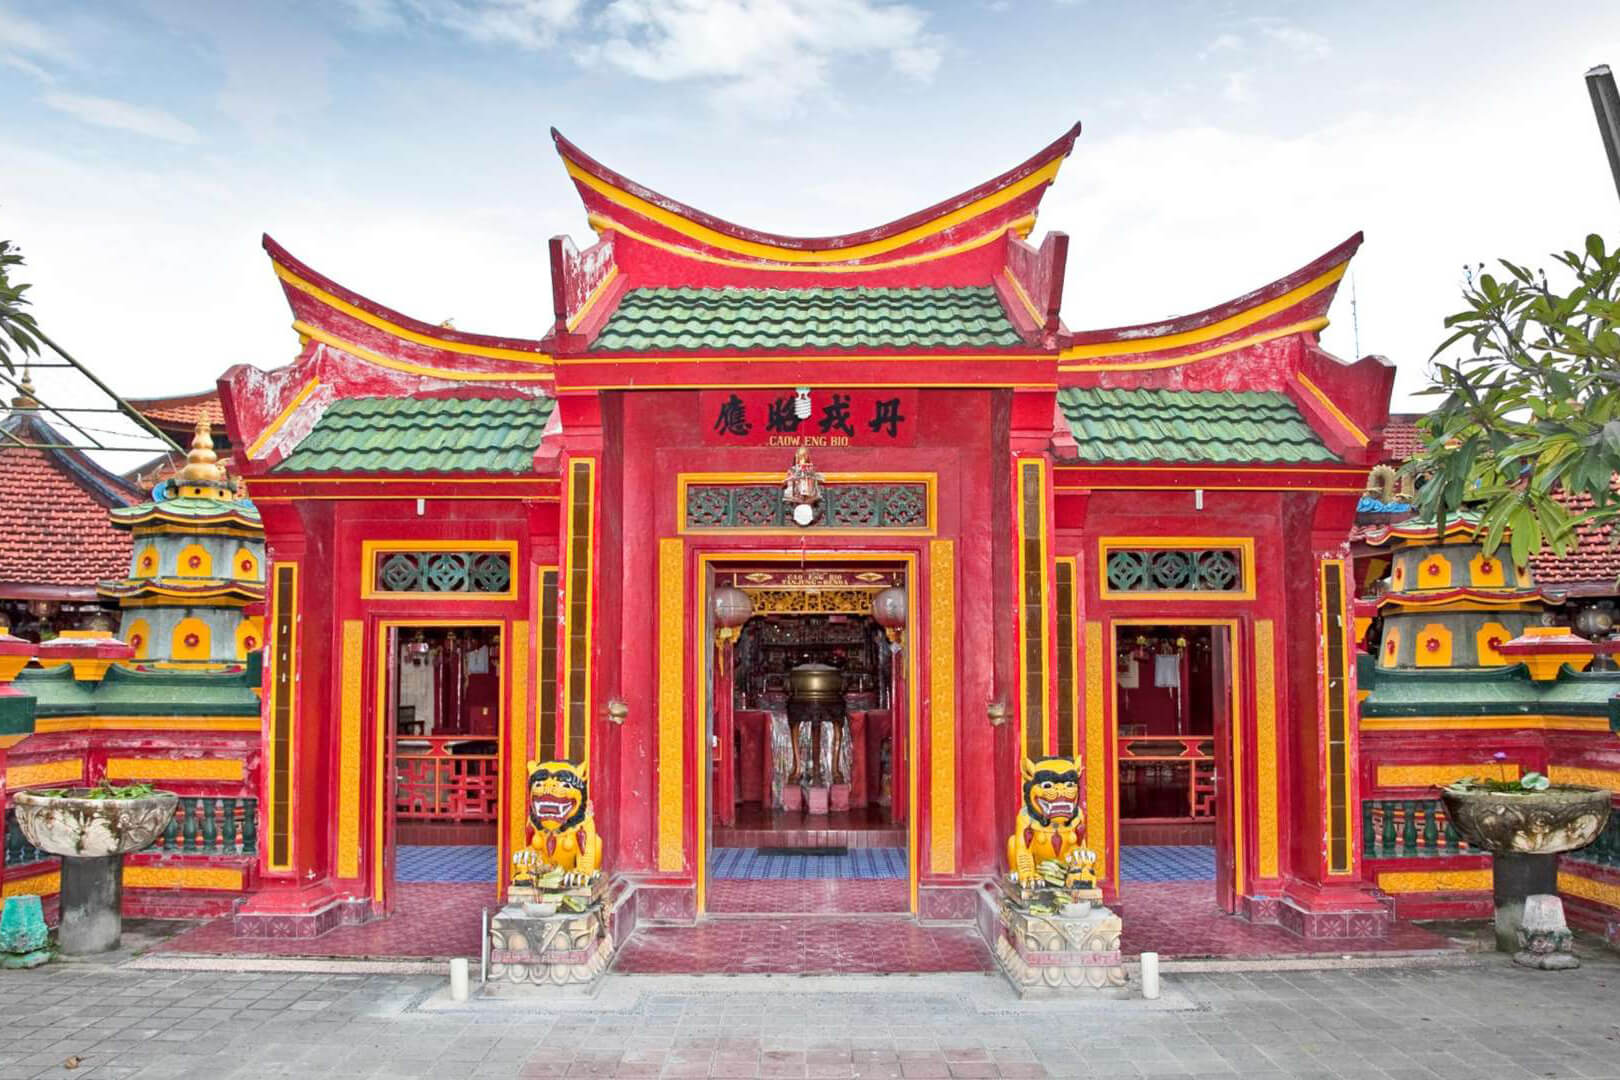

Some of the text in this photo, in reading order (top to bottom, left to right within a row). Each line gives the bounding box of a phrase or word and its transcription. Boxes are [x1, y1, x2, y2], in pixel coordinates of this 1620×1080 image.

[769, 435, 849, 447] CAOW ENG BIO
